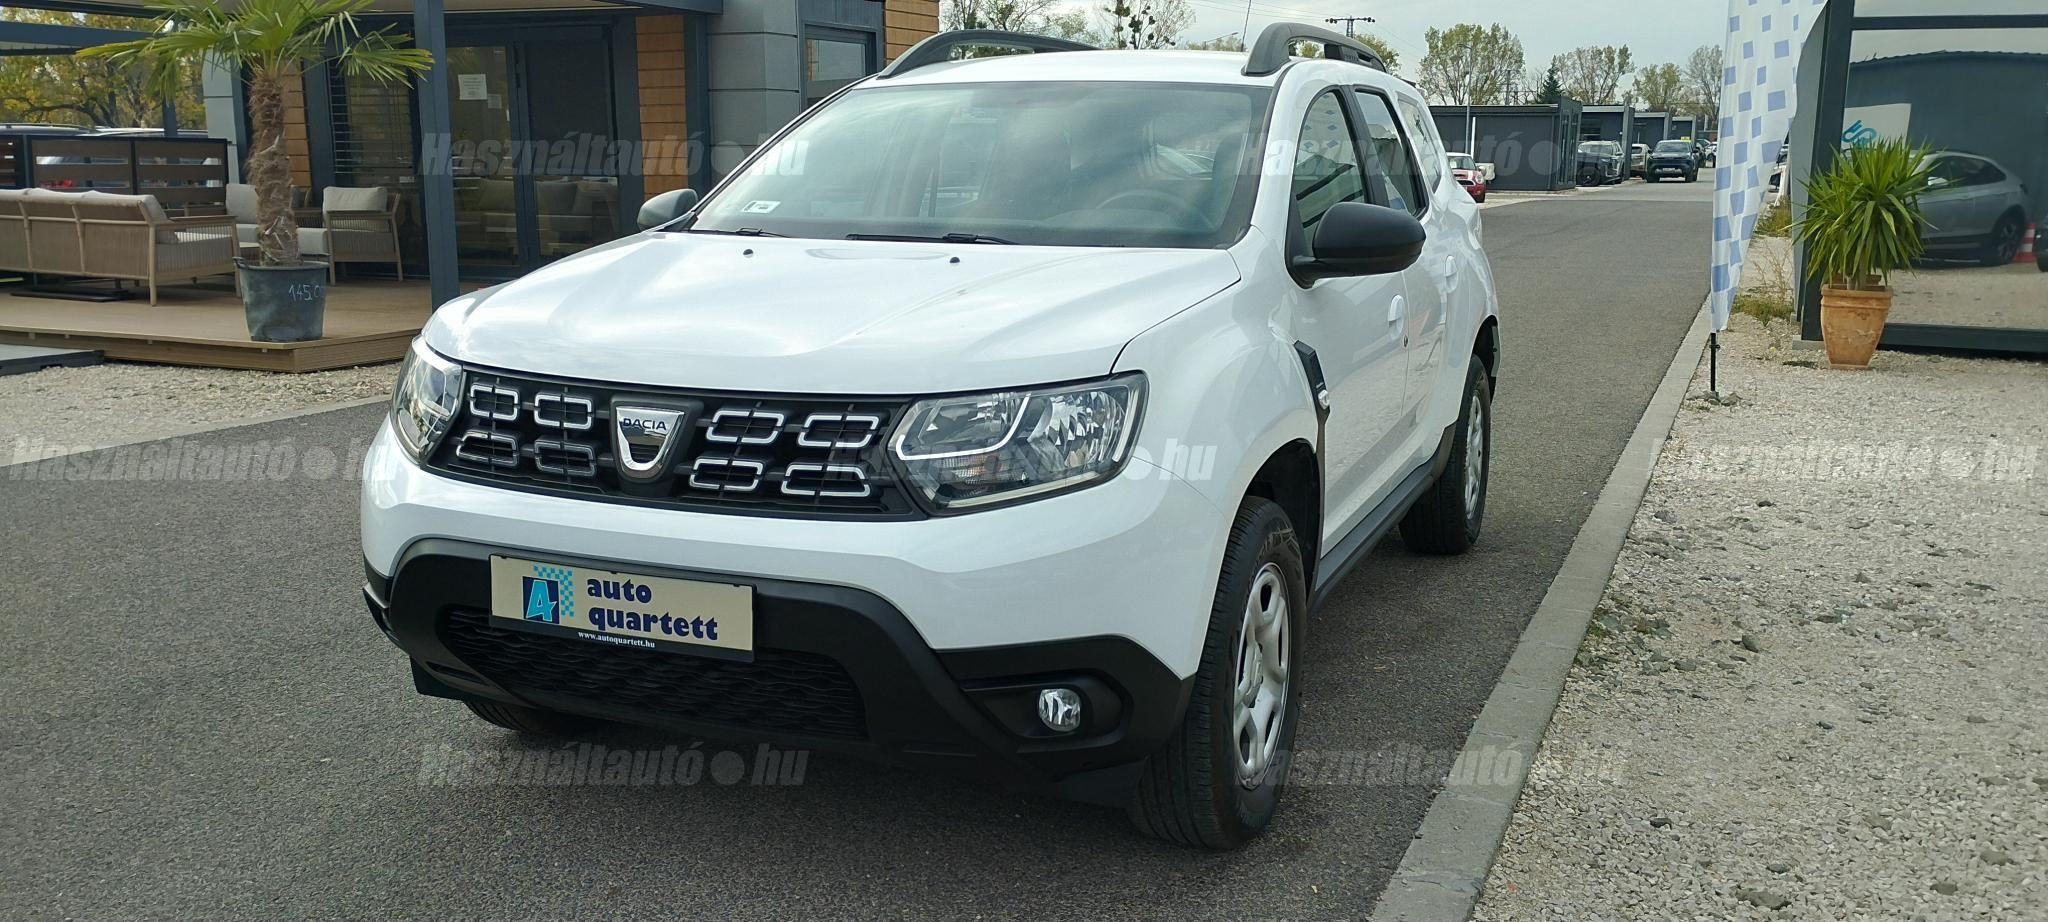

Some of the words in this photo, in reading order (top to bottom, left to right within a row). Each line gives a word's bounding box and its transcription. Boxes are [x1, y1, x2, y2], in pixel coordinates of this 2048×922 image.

[622, 418, 667, 431] DACIA
[587, 578, 652, 603] auto
[588, 606, 718, 641] quartett
[578, 630, 656, 649] www.autoquartett.hu
